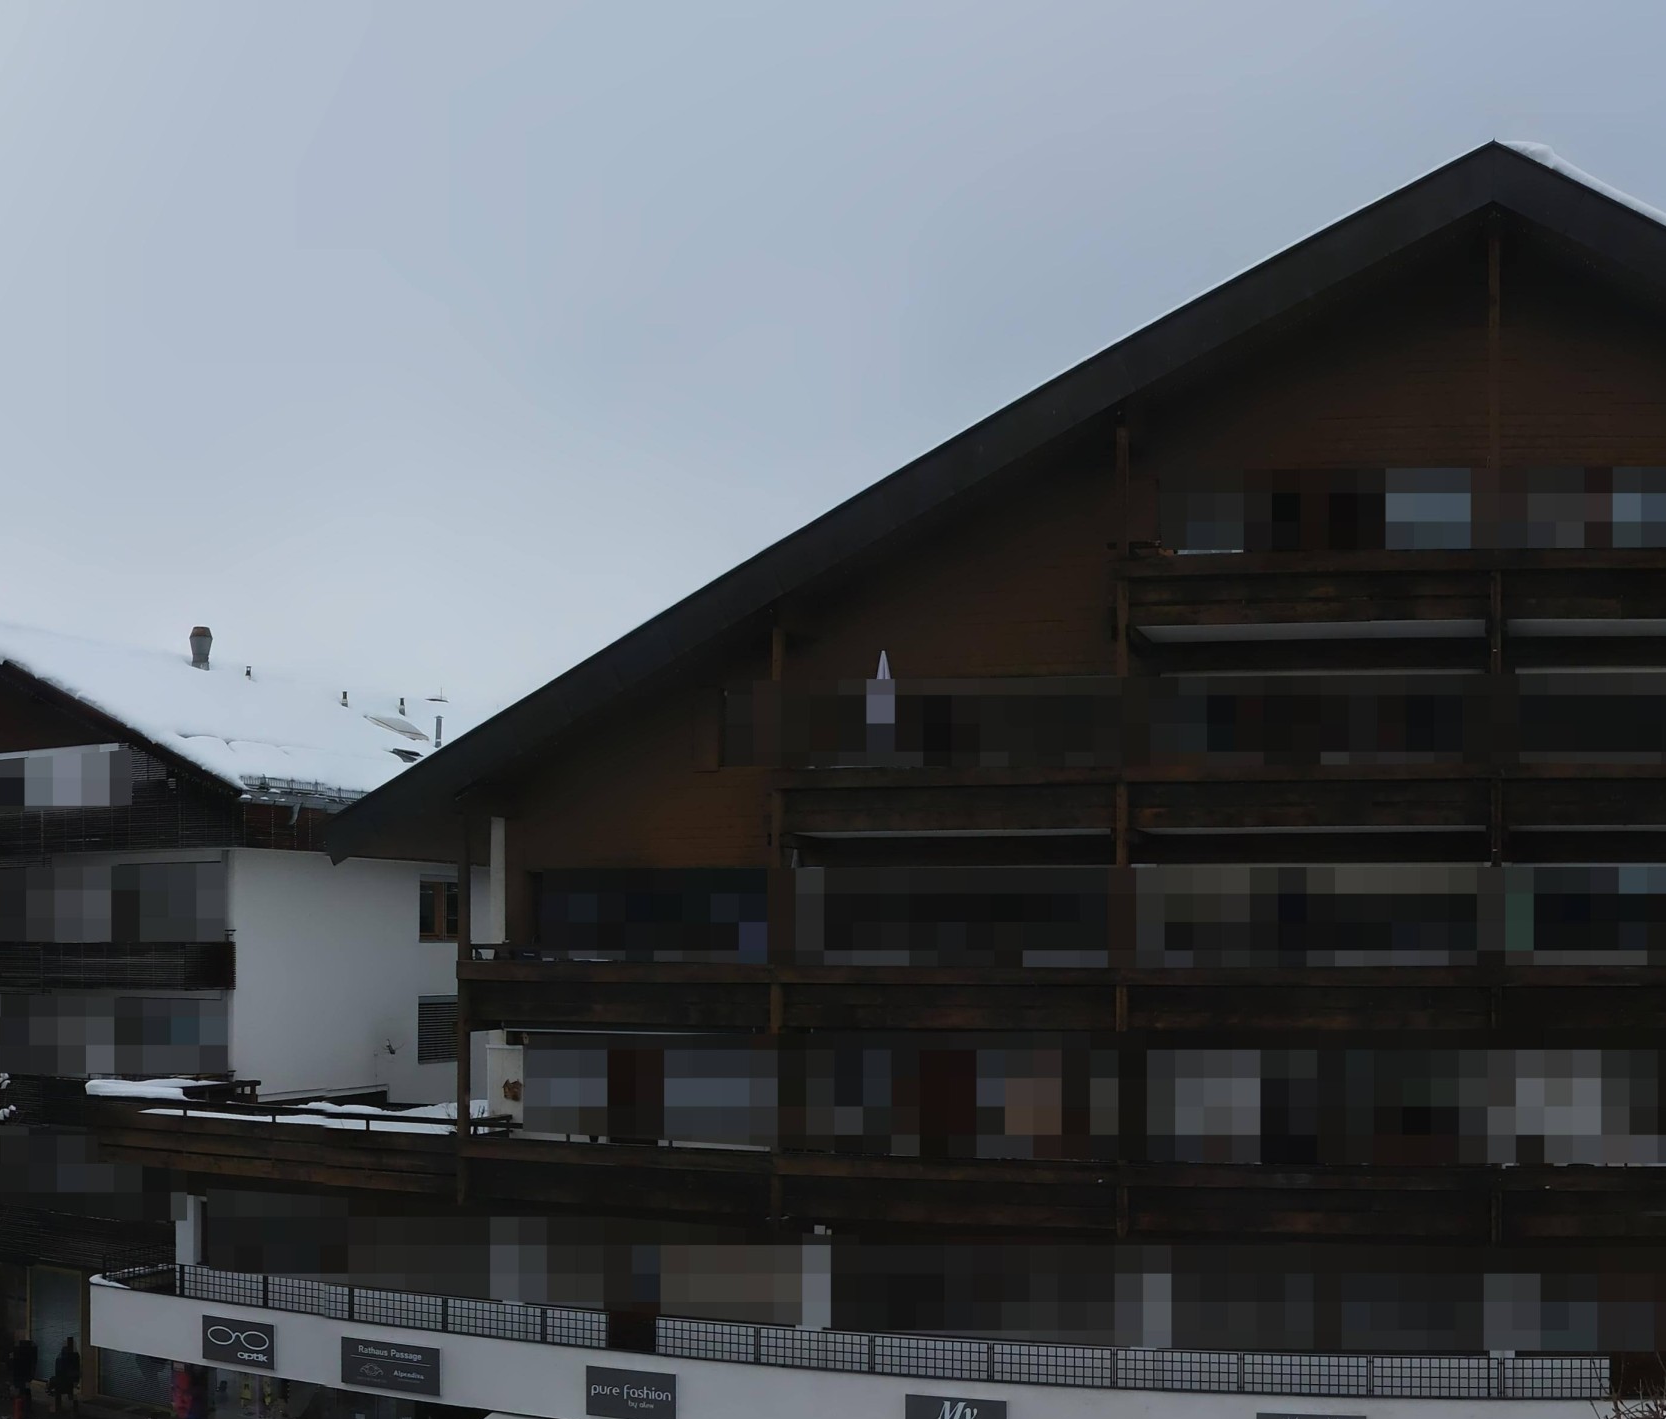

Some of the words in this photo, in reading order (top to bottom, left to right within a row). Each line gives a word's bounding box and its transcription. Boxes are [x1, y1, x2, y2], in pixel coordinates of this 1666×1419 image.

[237, 1351, 268, 1363] optik
[358, 1344, 389, 1357] Rathaus
[390, 1349, 422, 1362] Passage
[591, 1384, 620, 1397] pure
[623, 1384, 672, 1402] fashion
[628, 1400, 638, 1409] by
